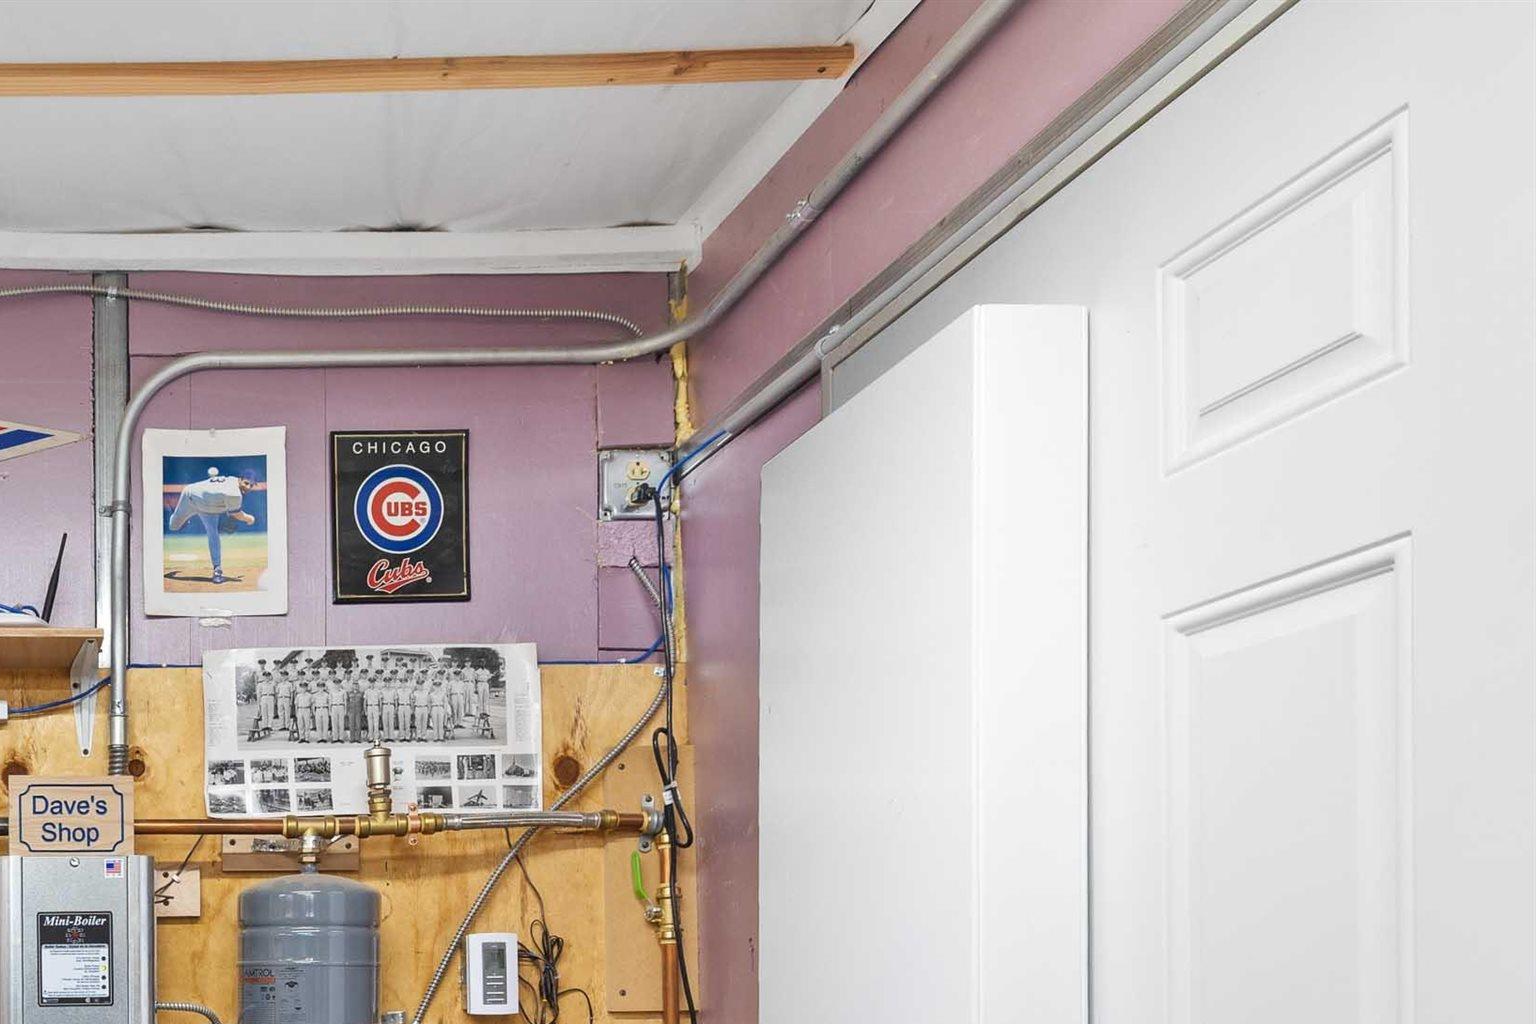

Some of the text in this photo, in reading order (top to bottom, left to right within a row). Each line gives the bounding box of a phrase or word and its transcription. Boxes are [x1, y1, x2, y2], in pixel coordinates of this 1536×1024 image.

[352, 440, 448, 455] CHICAGO
[371, 481, 428, 538] CUBS
[366, 557, 430, 594] Cubs
[32, 794, 109, 816] Dave's
[41, 822, 100, 847] Shop
[43, 915, 107, 927] Mini-Boiler
